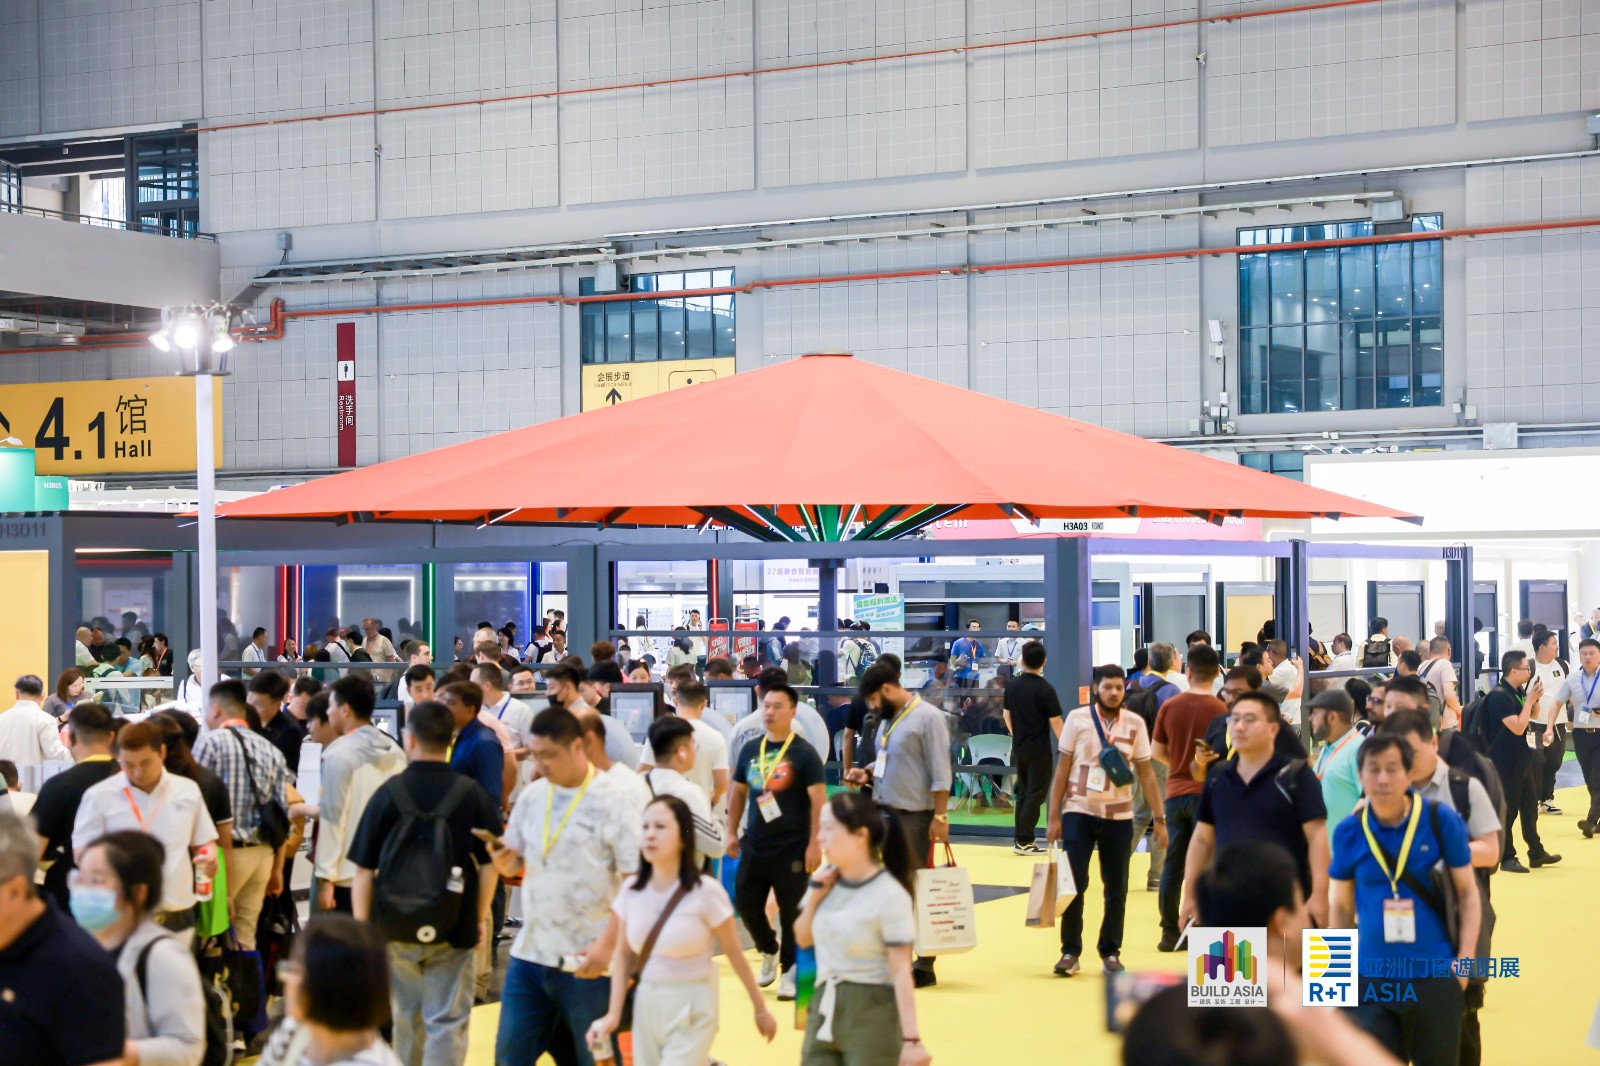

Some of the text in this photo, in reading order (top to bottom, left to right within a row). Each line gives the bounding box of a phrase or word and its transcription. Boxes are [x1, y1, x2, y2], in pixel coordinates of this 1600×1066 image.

[597, 371, 630, 382] 会展步道
[345, 394, 354, 426] 洗手间
[35, 394, 147, 460] 4.1 馆
[114, 439, 151, 458] Hall
[0, 522, 46, 538] H3D11
[1063, 522, 1088, 530] H3A03
[1442, 546, 1463, 559] H3D11
